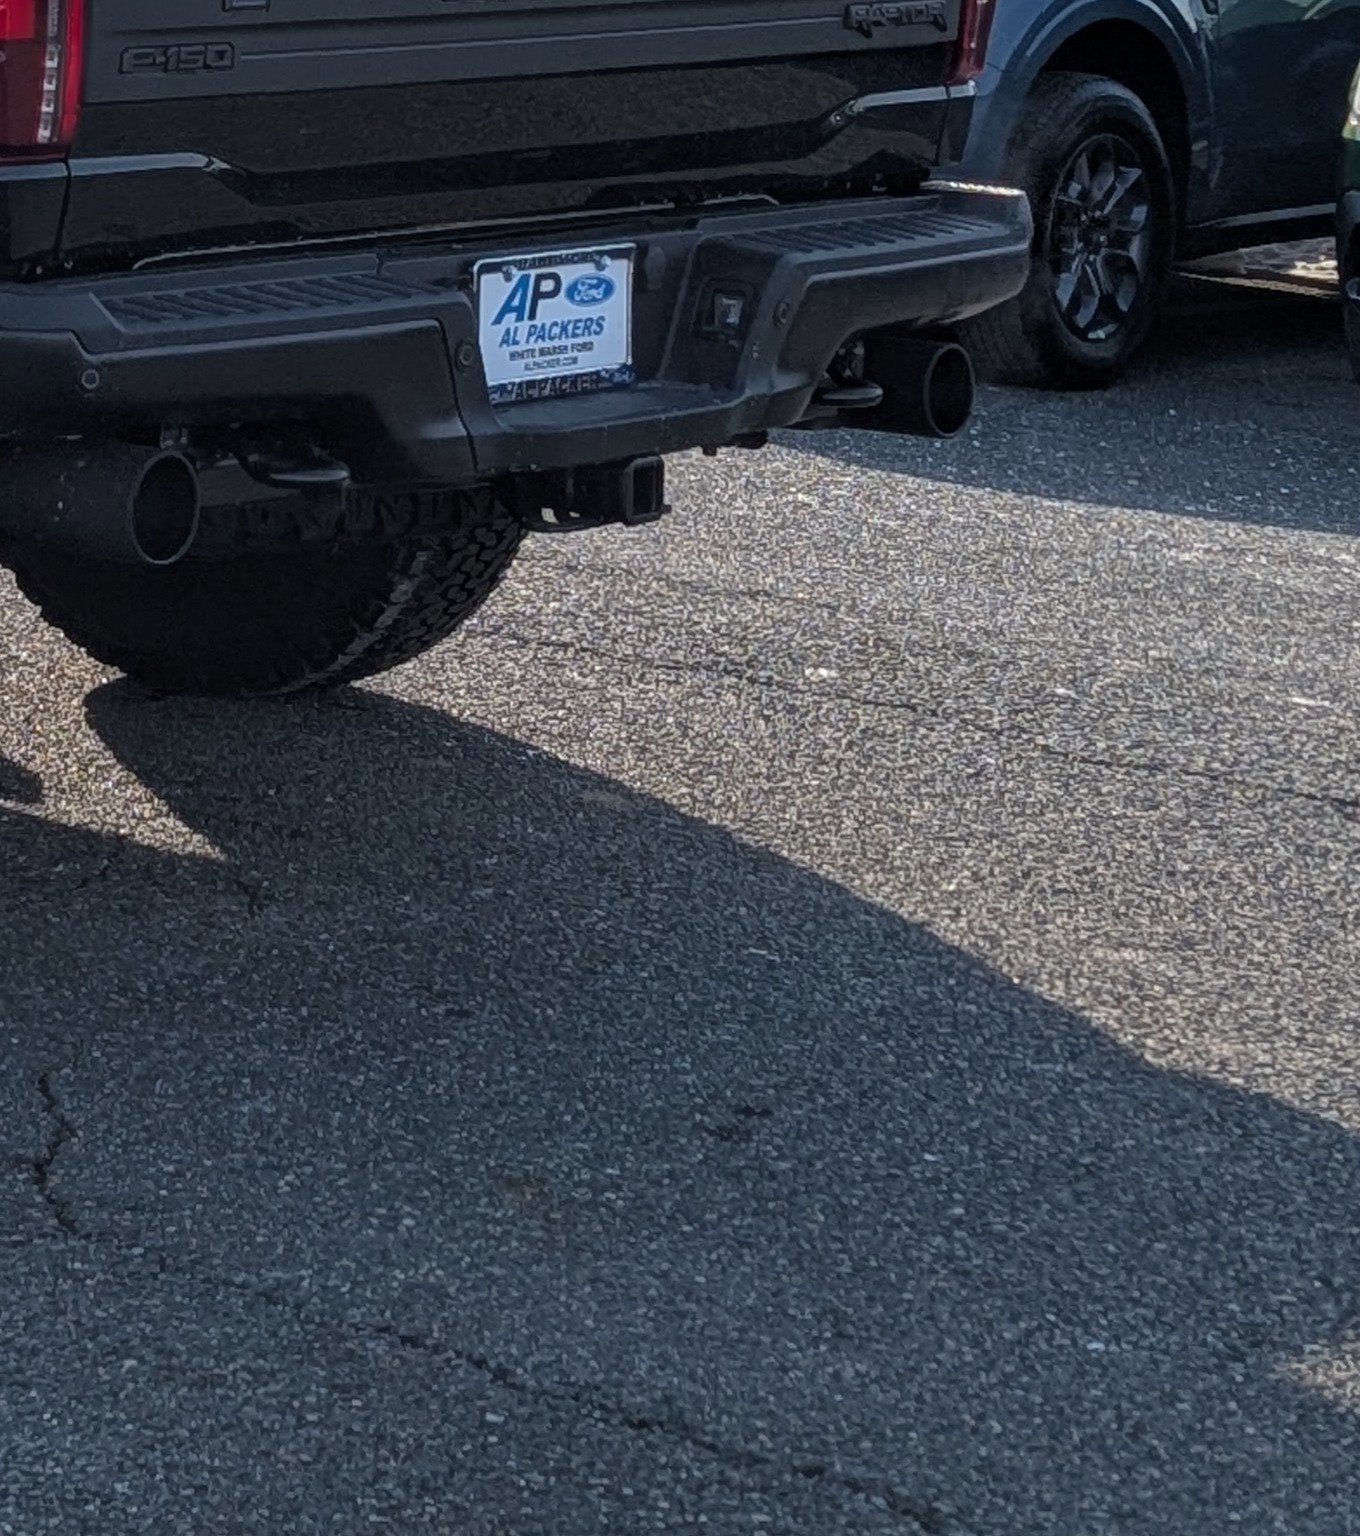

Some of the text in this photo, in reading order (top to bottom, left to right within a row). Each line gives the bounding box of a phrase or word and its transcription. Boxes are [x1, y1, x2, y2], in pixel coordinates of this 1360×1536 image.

[118, 40, 236, 75] F-150
[491, 271, 563, 327] AP
[572, 277, 607, 302] Ford
[498, 316, 606, 348] AL PACKERS
